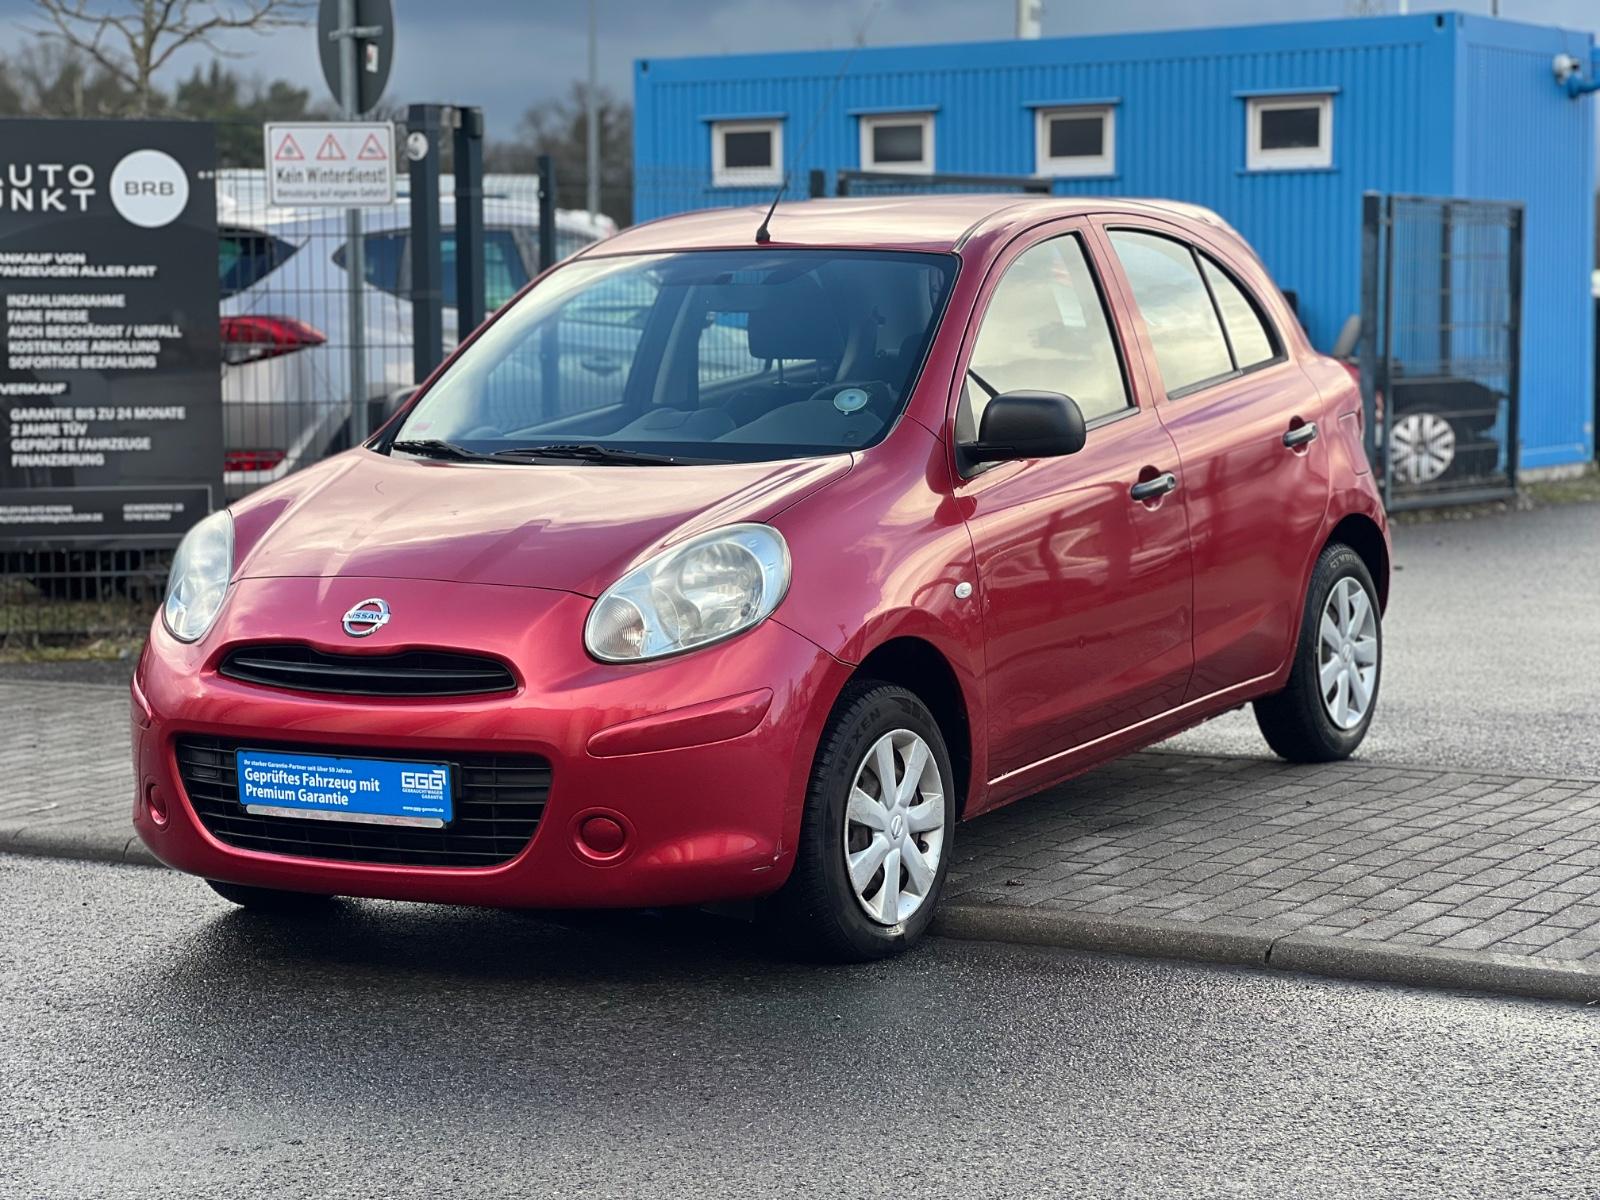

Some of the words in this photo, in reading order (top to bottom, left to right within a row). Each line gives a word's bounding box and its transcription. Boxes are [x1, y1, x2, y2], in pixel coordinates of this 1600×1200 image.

[0, 164, 94, 188] UTO
[276, 167, 304, 183] Kein
[125, 181, 174, 196] BRB
[0, 188, 96, 212] NKT
[54, 253, 87, 265] VON
[80, 265, 126, 277] ALLER
[127, 265, 158, 277] ART
[7, 309, 43, 323] FAIRE
[45, 309, 89, 323] PREISE
[8, 325, 44, 338] AUCH
[46, 322, 124, 338] BESCHÄDIGT
[134, 325, 182, 338] UNFALL
[8, 340, 89, 353] KOSTENLOSE
[91, 340, 161, 353] ABHOLUNG
[9, 355, 79, 369] SOFORTIGE
[81, 355, 157, 369] BEZAHLUNG
[10, 408, 73, 421] GARANTIE
[75, 408, 96, 420] BIS
[97, 408, 115, 420] ZU
[117, 407, 133, 420] 24
[134, 406, 186, 419] MONATE
[10, 423, 20, 437] 2
[21, 423, 61, 436] JAHRE
[62, 421, 88, 436] TÜV
[11, 437, 75, 451] GEPRÜFTE
[77, 437, 151, 450] FAHRZEUGE
[11, 453, 105, 467] FINANZIERUNG
[347, 612, 384, 621] NISSAN
[267, 762, 307, 771] Garantie-Partner
[244, 768, 300, 785] Geprüftes
[302, 773, 357, 793] Fahrzeug
[359, 777, 380, 792] mit
[401, 771, 444, 790] GGG
[245, 783, 295, 801] Premium
[298, 789, 349, 805] Garantie
